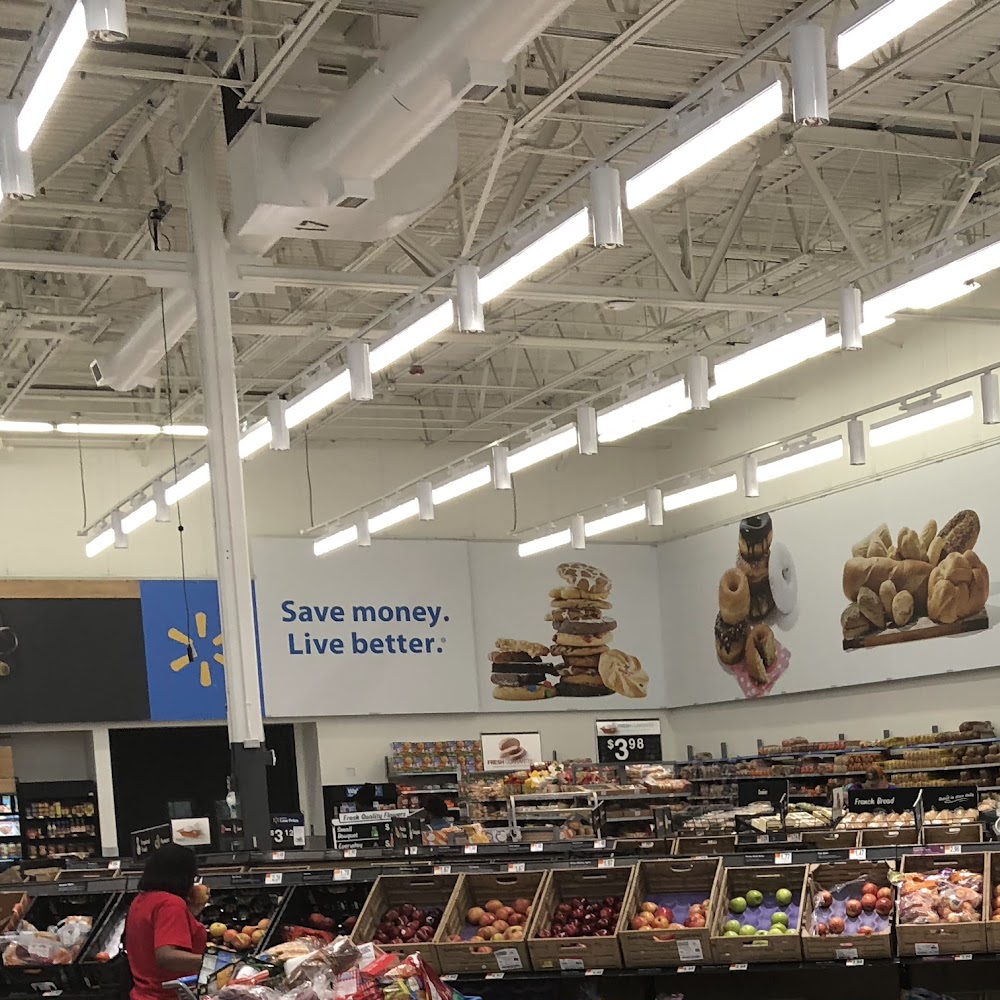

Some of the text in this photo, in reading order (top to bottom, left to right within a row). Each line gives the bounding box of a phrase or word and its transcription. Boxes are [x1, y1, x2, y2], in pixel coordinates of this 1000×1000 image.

[281, 600, 449, 628] Save money.
[288, 632, 443, 654] Live better.
[854, 796, 895, 806] French Bread
